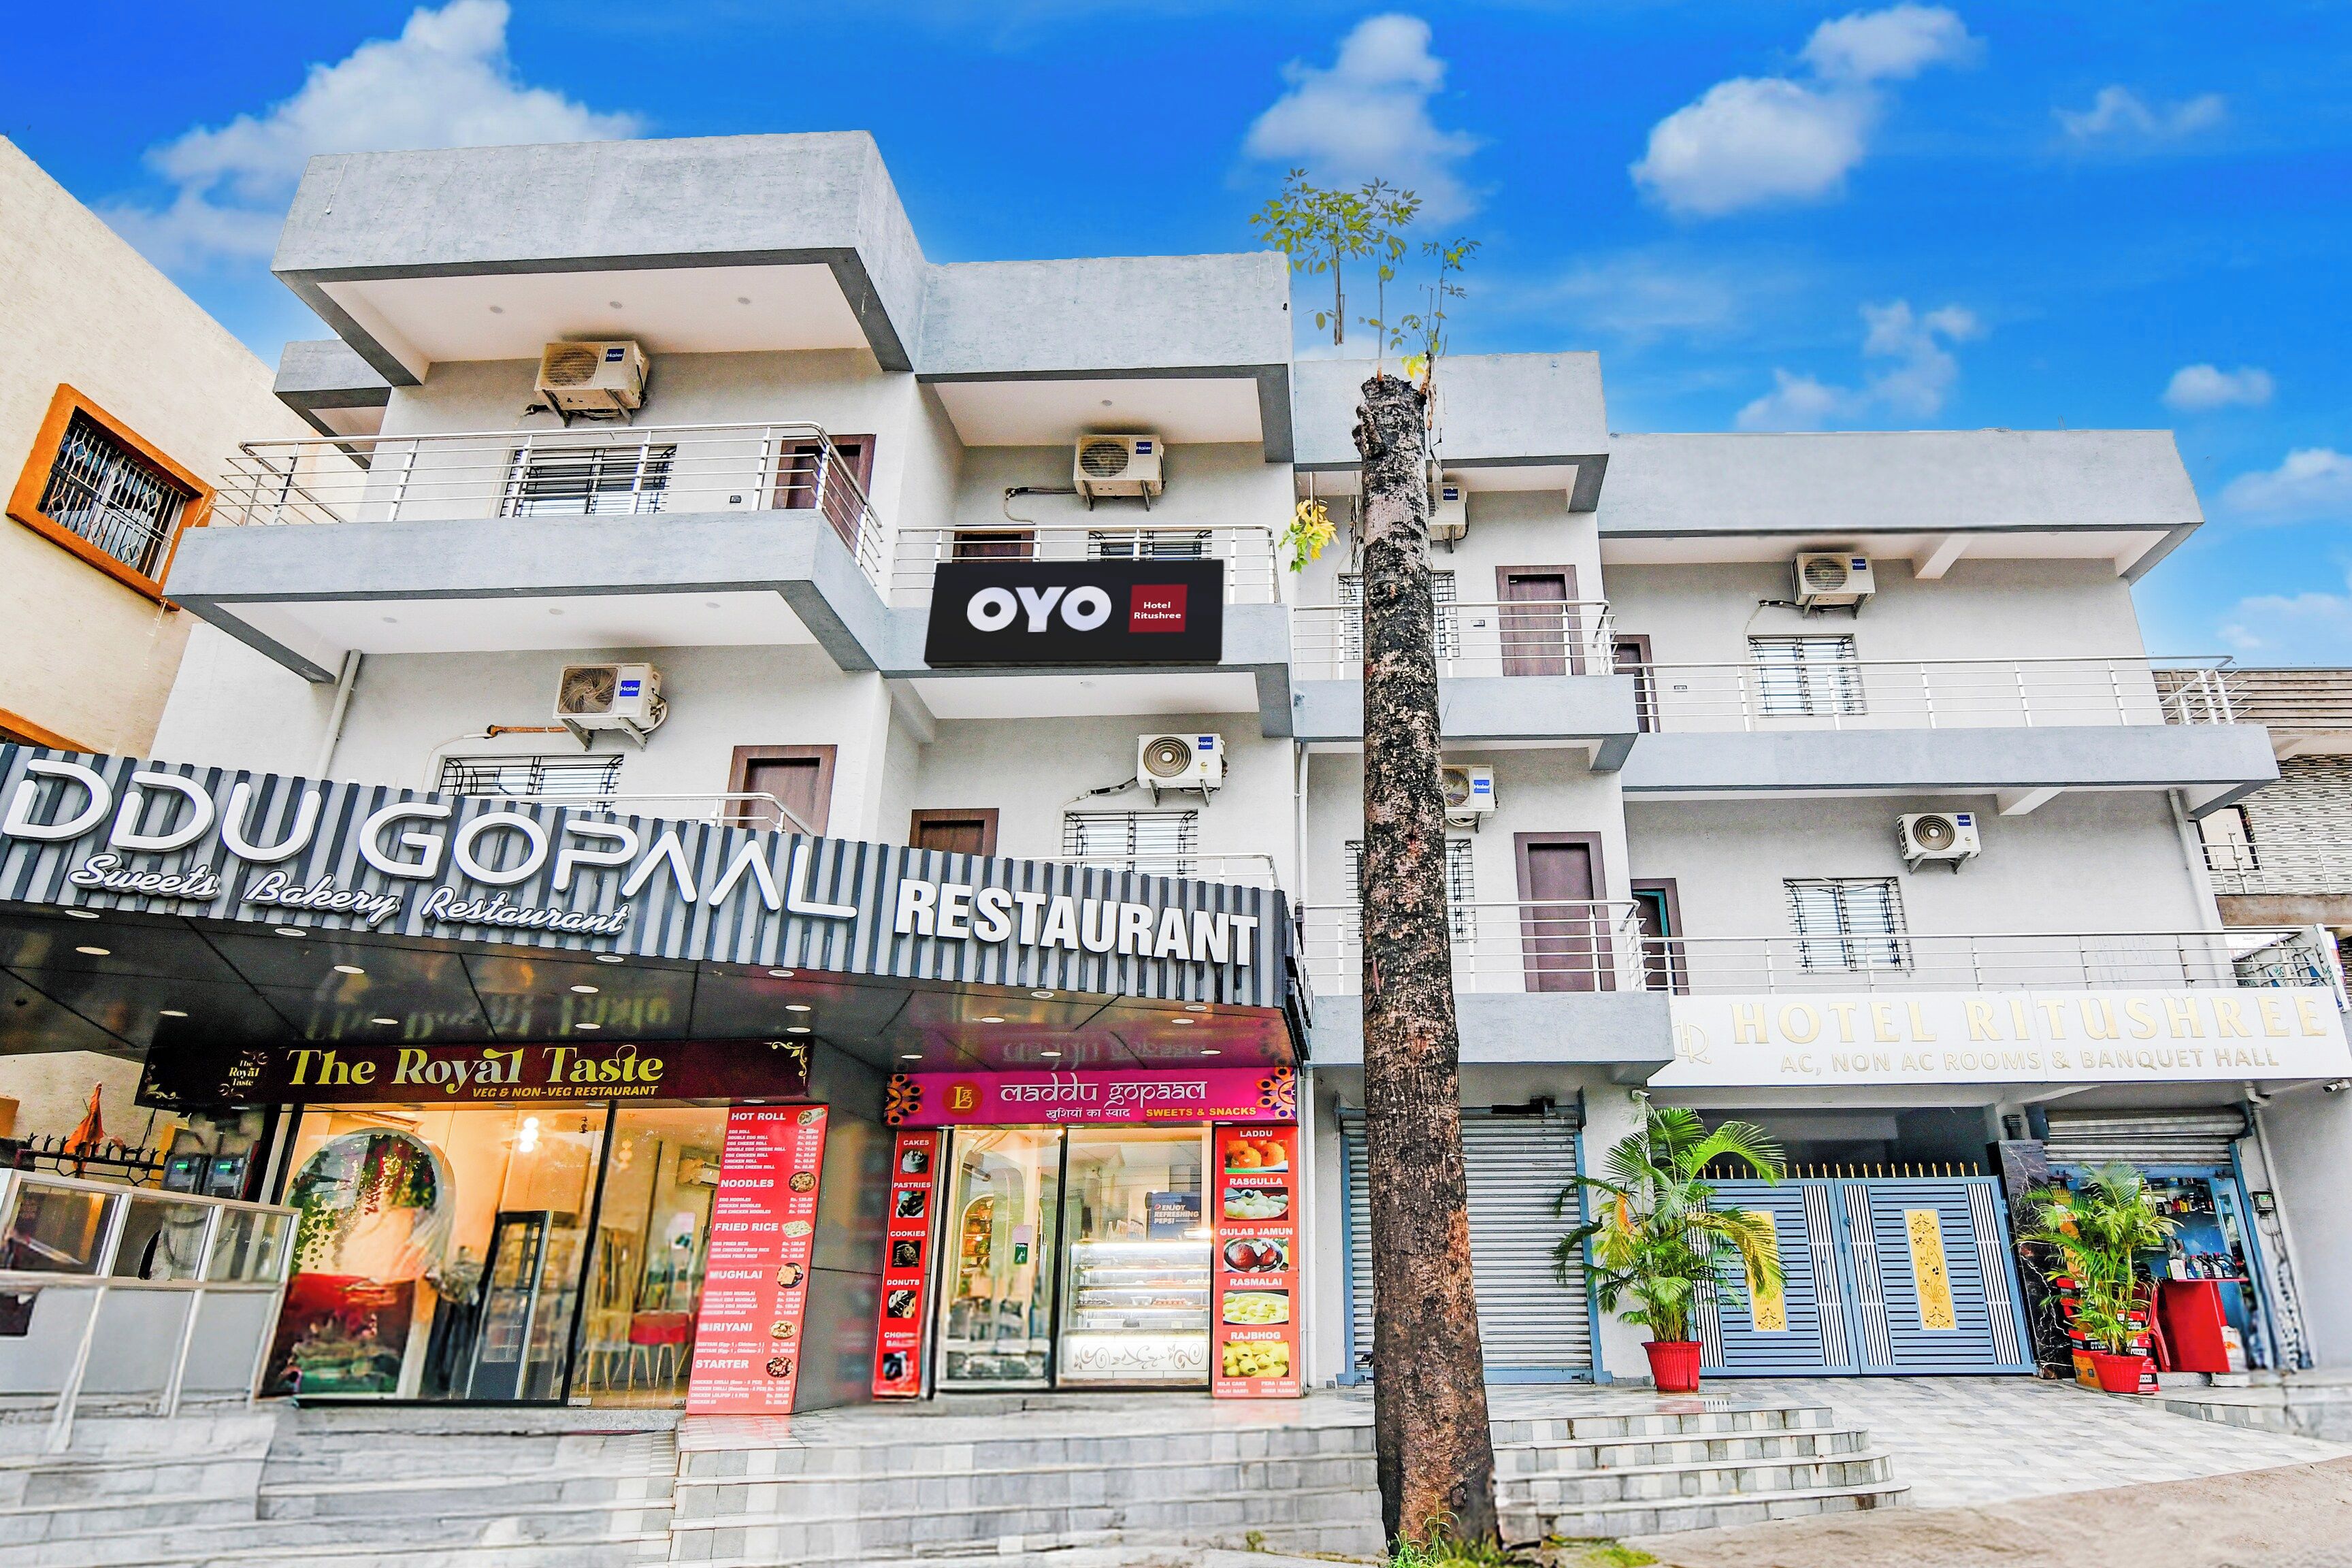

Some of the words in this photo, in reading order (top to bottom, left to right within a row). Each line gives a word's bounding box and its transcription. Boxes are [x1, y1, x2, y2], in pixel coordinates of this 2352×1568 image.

[966, 585, 1112, 632] OYO
[1143, 601, 1171, 609] Hotel
[1134, 611, 1181, 620] Ritushree
[2, 758, 322, 863] DDU
[359, 802, 858, 919] GOPAAL
[69, 852, 222, 900] Sweets
[241, 870, 402, 928] Bakery
[421, 886, 631, 936] Restaurant
[894, 878, 1258, 966] RESTAURANT
[1729, 1000, 1937, 1044] HOTEL
[1963, 996, 2328, 1041] RITUSHREE
[1781, 1053, 1822, 1076] AC,
[1831, 1051, 1891, 1072] NON
[1901, 1051, 1934, 1071] AC
[1943, 1050, 2042, 1072] ROOMS
[2052, 1049, 2071, 1069] &
[2080, 1047, 2204, 1071] BANQUET
[2215, 1047, 2280, 1068] HALL
[229, 1067, 260, 1079] Royal
[287, 1049, 376, 1085] The
[391, 1047, 524, 1094] Royal
[542, 1045, 664, 1083] Taste
[472, 1087, 495, 1098] VEG
[499, 1087, 508, 1097] &
[512, 1086, 572, 1097] NON-VEG
[574, 1085, 659, 1097] RESTAURANT
[1000, 1073, 1099, 1102] laddu
[1103, 1081, 1207, 1109] gopaal
[731, 1112, 755, 1121] HOT
[757, 1112, 787, 1121] ROLL
[1045, 1107, 1083, 1122] खुशियों
[1087, 1109, 1101, 1118] का
[1105, 1108, 1130, 1118] स्वाद
[1146, 1107, 1195, 1117] SWEETS
[1197, 1107, 1205, 1116] &
[1209, 1107, 1257, 1116] SNACKS
[721, 1179, 774, 1188] NOODLES
[1229, 1177, 1283, 1186] RASGULLA
[715, 1223, 749, 1231] FRIED
[751, 1223, 779, 1231] RICE
[1220, 1227, 1255, 1236] GULAB
[1257, 1227, 1293, 1236] JAMUN
[1230, 1278, 1282, 1286] RASMALAI
[1230, 1331, 1281, 1340] RAJBHOG
[696, 1359, 749, 1369] STARTER
